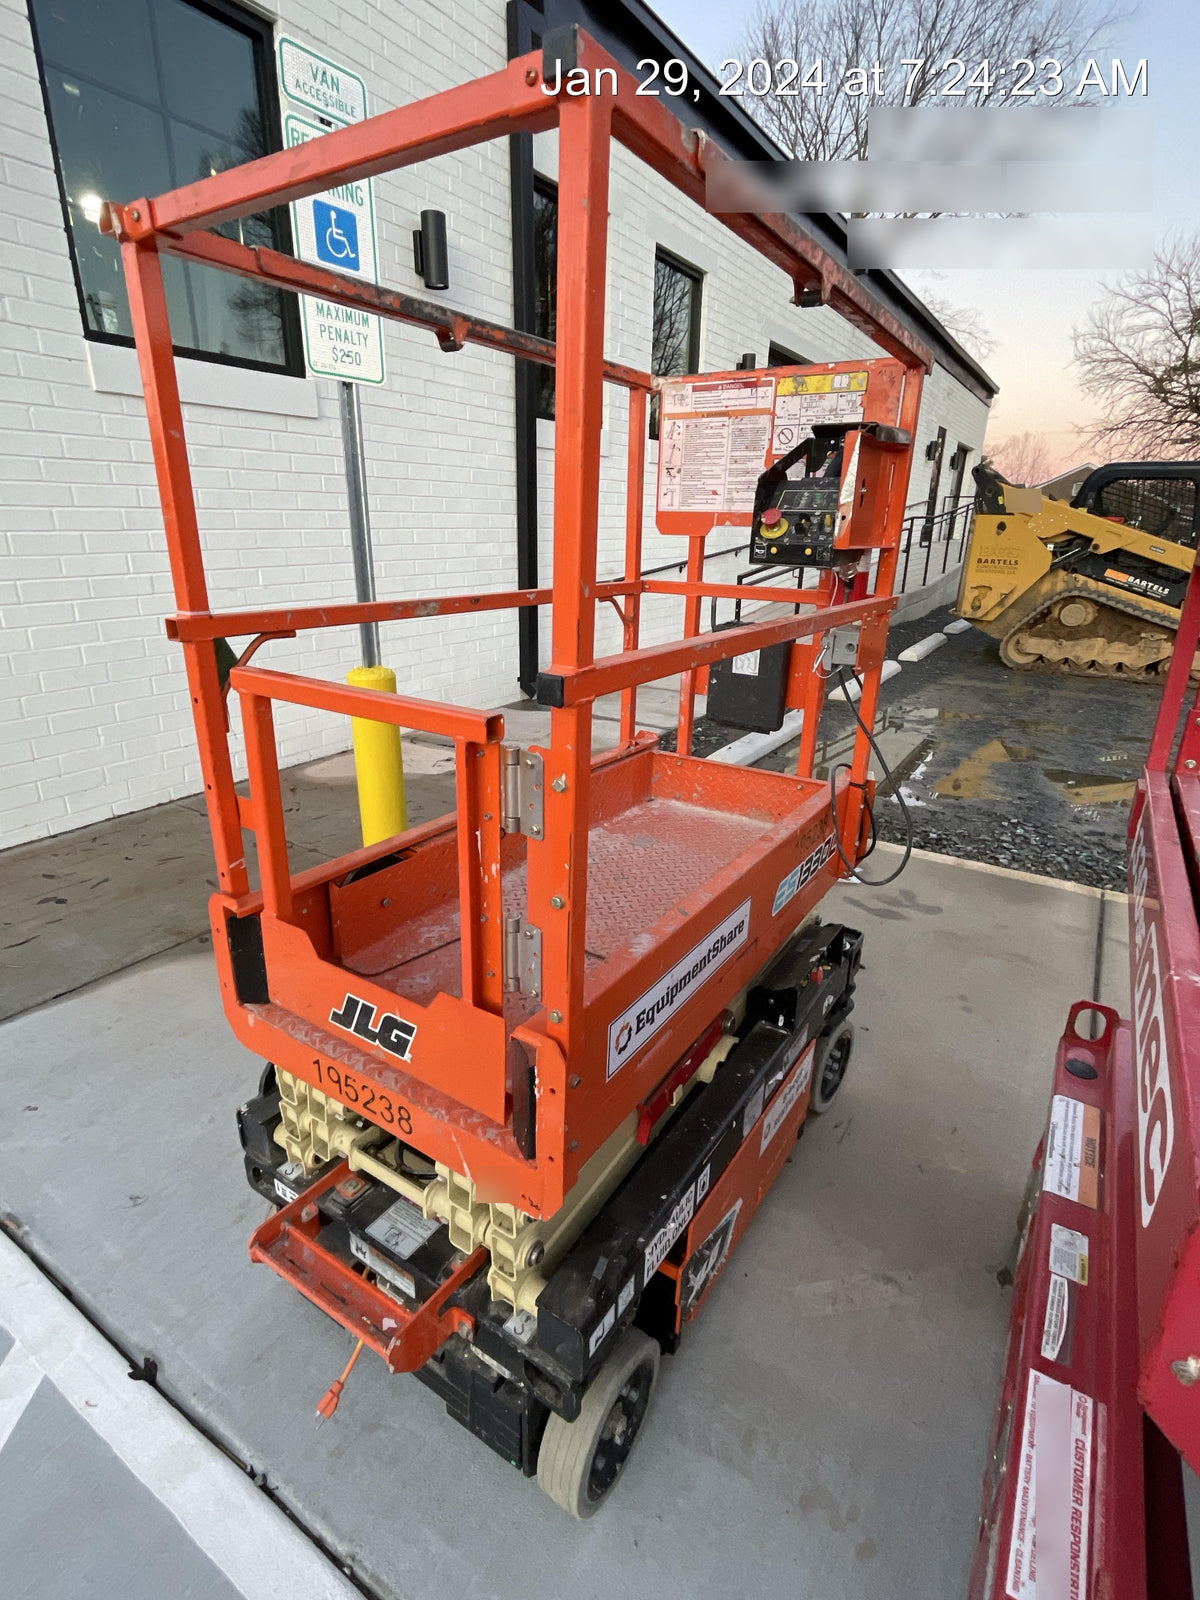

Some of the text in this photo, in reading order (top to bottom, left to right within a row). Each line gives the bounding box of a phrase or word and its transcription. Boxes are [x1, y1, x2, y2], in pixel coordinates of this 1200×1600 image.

[310, 64, 340, 94] VAN
[295, 78, 357, 118] ACCESSIBLE
[325, 184, 366, 207] KING
[316, 302, 370, 328] MAXIMUM
[319, 324, 369, 348] PENALTY
[332, 346, 362, 366] $250
[977, 558, 1019, 566] BARTELS
[1127, 575, 1170, 595] BARTELS
[635, 918, 745, 1036] EquipmentShare
[329, 993, 417, 1060] JLG
[1135, 932, 1171, 1212] mec
[312, 1059, 413, 1135] 195238
[1084, 1137, 1097, 1168] NOTICE
[672, 1206, 693, 1240] ONLY
[1024, 1453, 1033, 1485] BATTERY
[1072, 1438, 1087, 1507] CUSTOMER
[1017, 1486, 1030, 1543] MAINTENANCE
[1012, 1548, 1024, 1593] CLEANING
